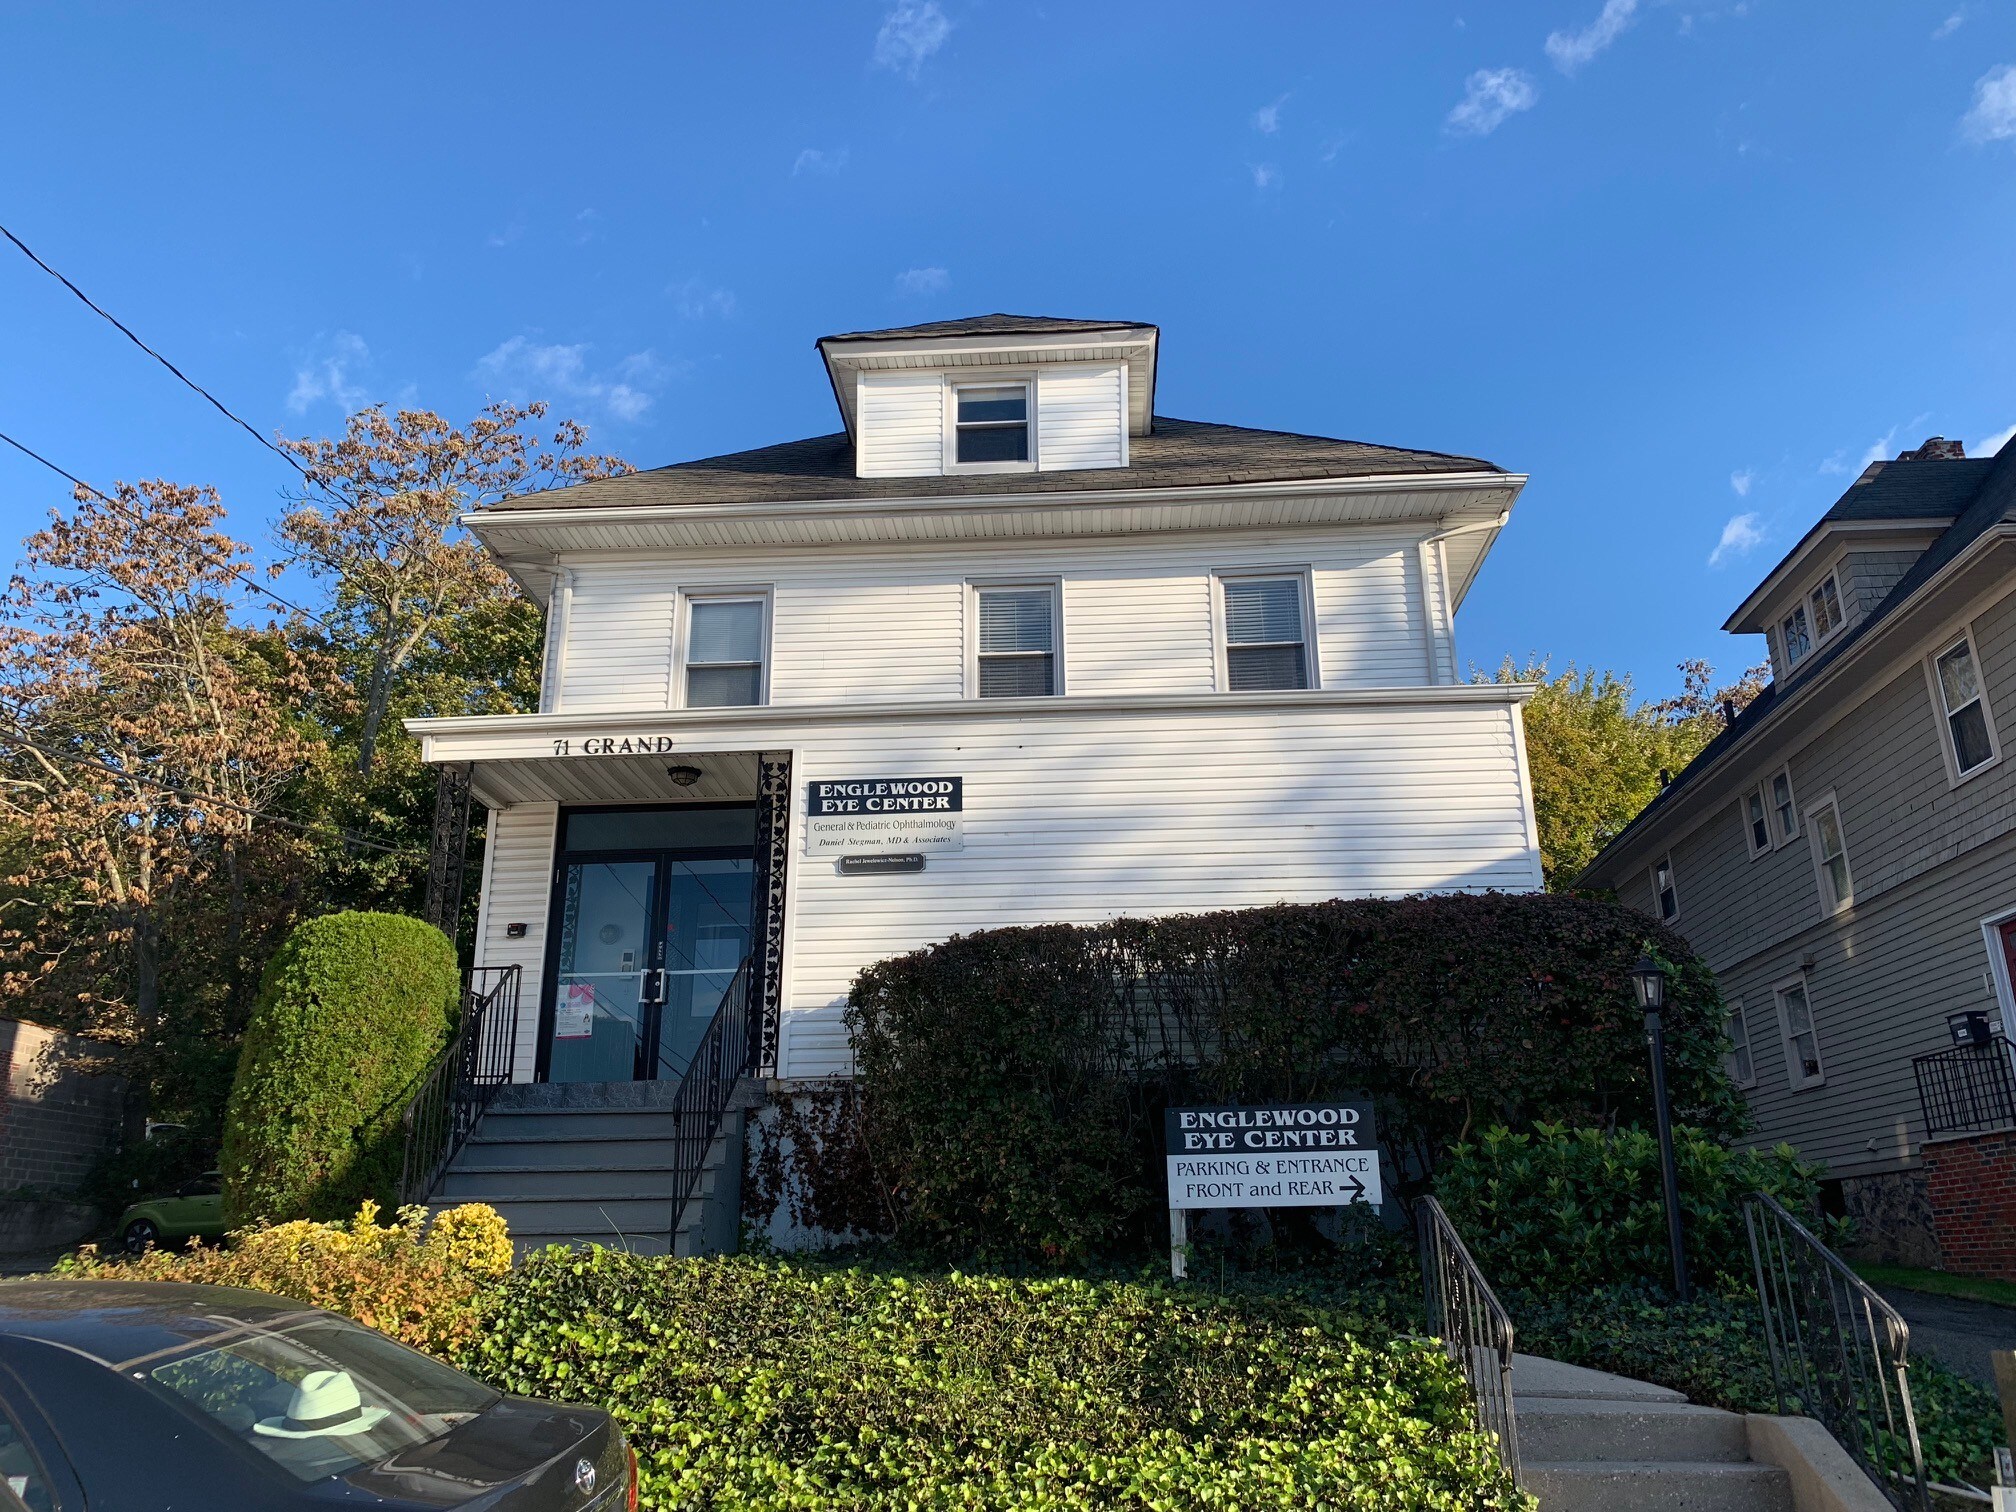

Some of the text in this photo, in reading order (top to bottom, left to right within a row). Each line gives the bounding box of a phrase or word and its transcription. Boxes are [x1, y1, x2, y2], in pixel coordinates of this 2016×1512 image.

[553, 736, 673, 755] 71 GRAND
[819, 781, 953, 797] ENGLEWOOD
[821, 796, 950, 812] EYE CENTER
[813, 819, 956, 831] General & Pediatric Ophthalmology
[819, 838, 845, 846] Daniel
[848, 837, 883, 846] Stegman,
[886, 836, 902, 844] MD
[912, 835, 951, 844] Associates
[1179, 1108, 1360, 1129] ENGLEWOOD
[1184, 1129, 1358, 1149] EYE CENTER
[1177, 1157, 1369, 1176] PARKING & ENTRANCE
[1186, 1180, 1334, 1198] FRONT and REAR
